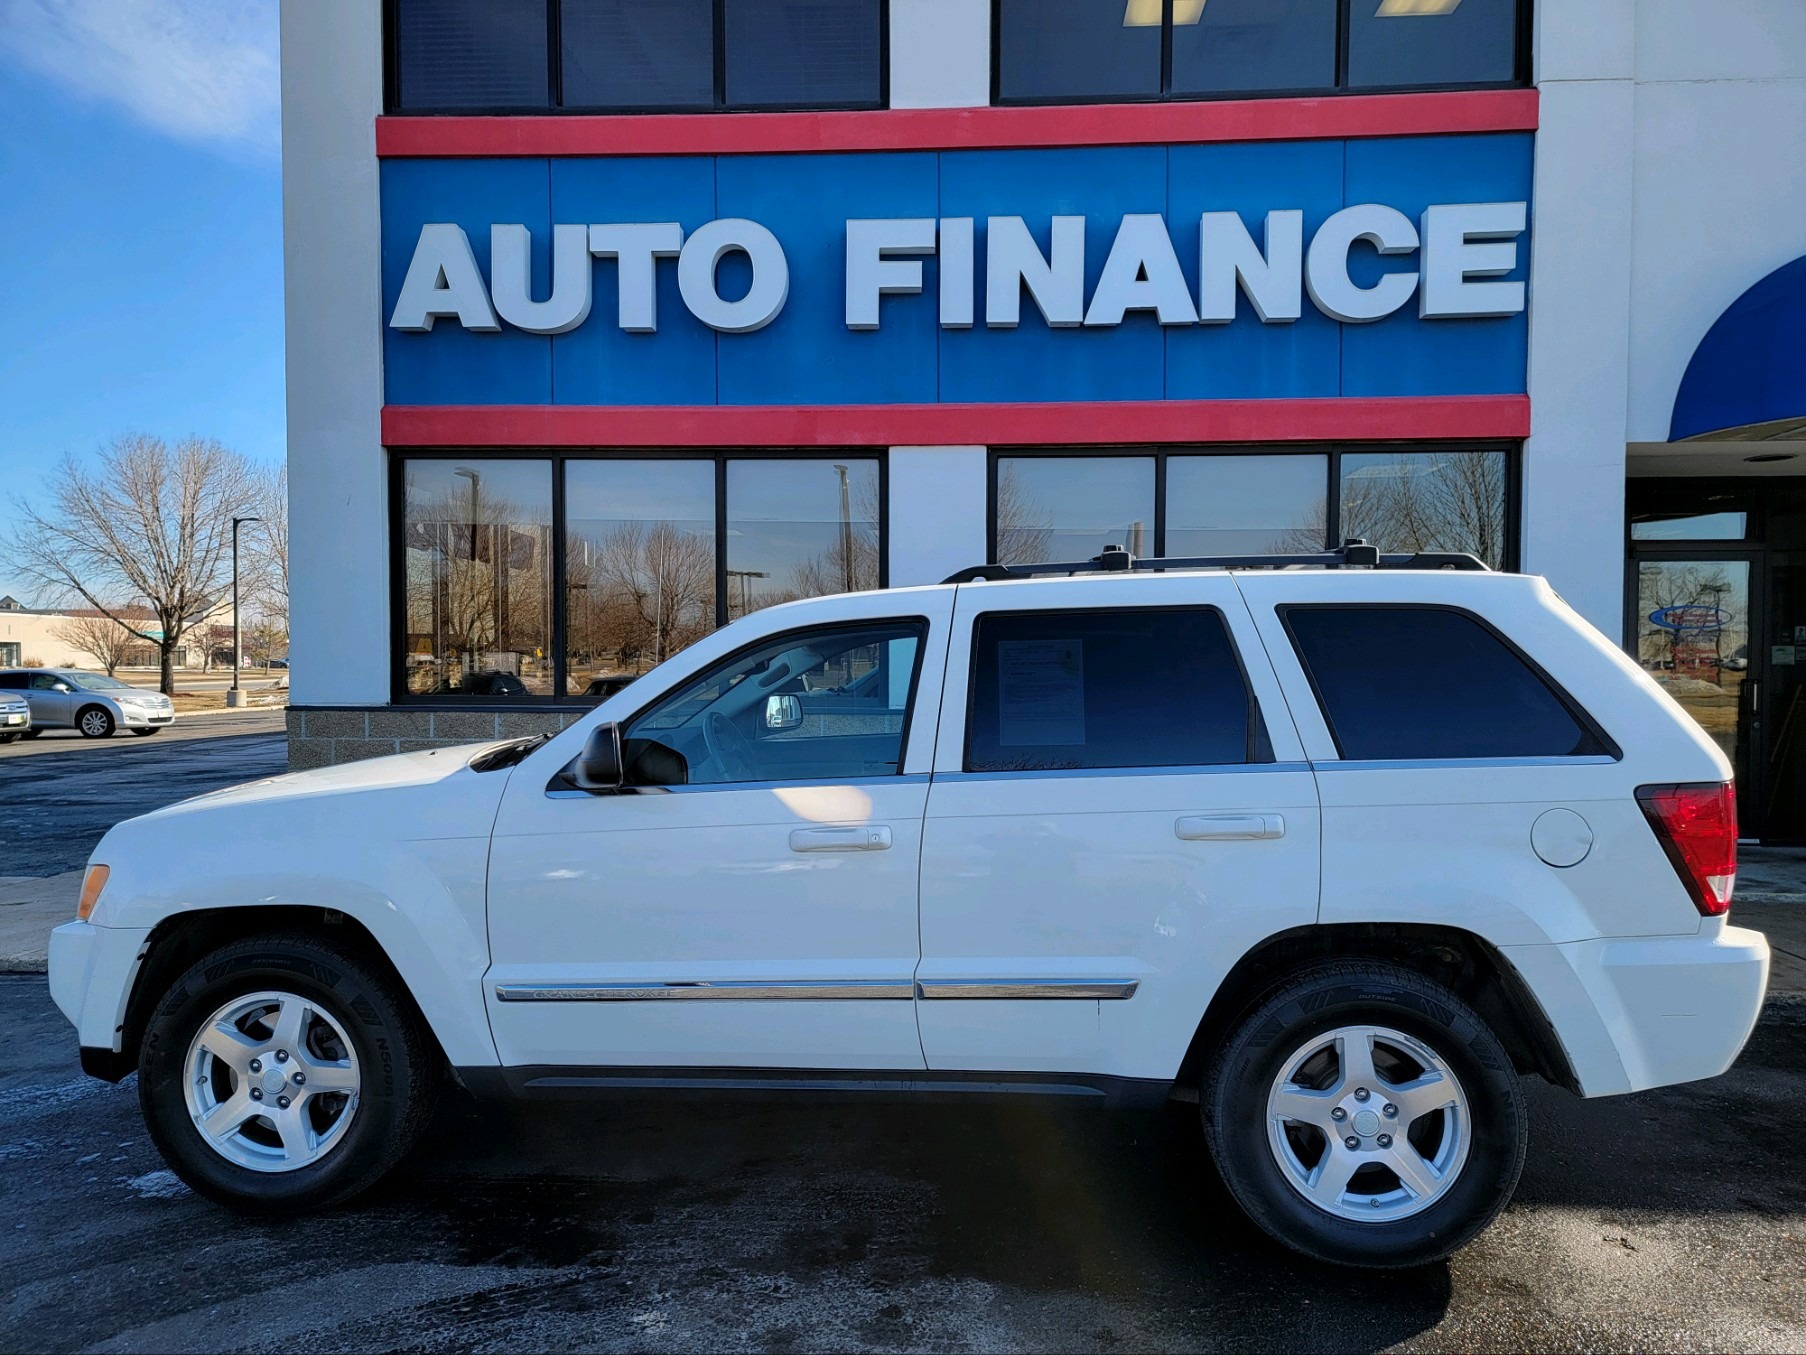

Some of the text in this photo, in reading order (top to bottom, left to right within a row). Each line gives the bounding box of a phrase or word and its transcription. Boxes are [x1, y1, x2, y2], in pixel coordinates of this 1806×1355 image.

[389, 201, 1527, 334] AUTO FINANCE
[533, 988, 586, 999] GRAND
[1358, 994, 1398, 1002] OUTSIDE
